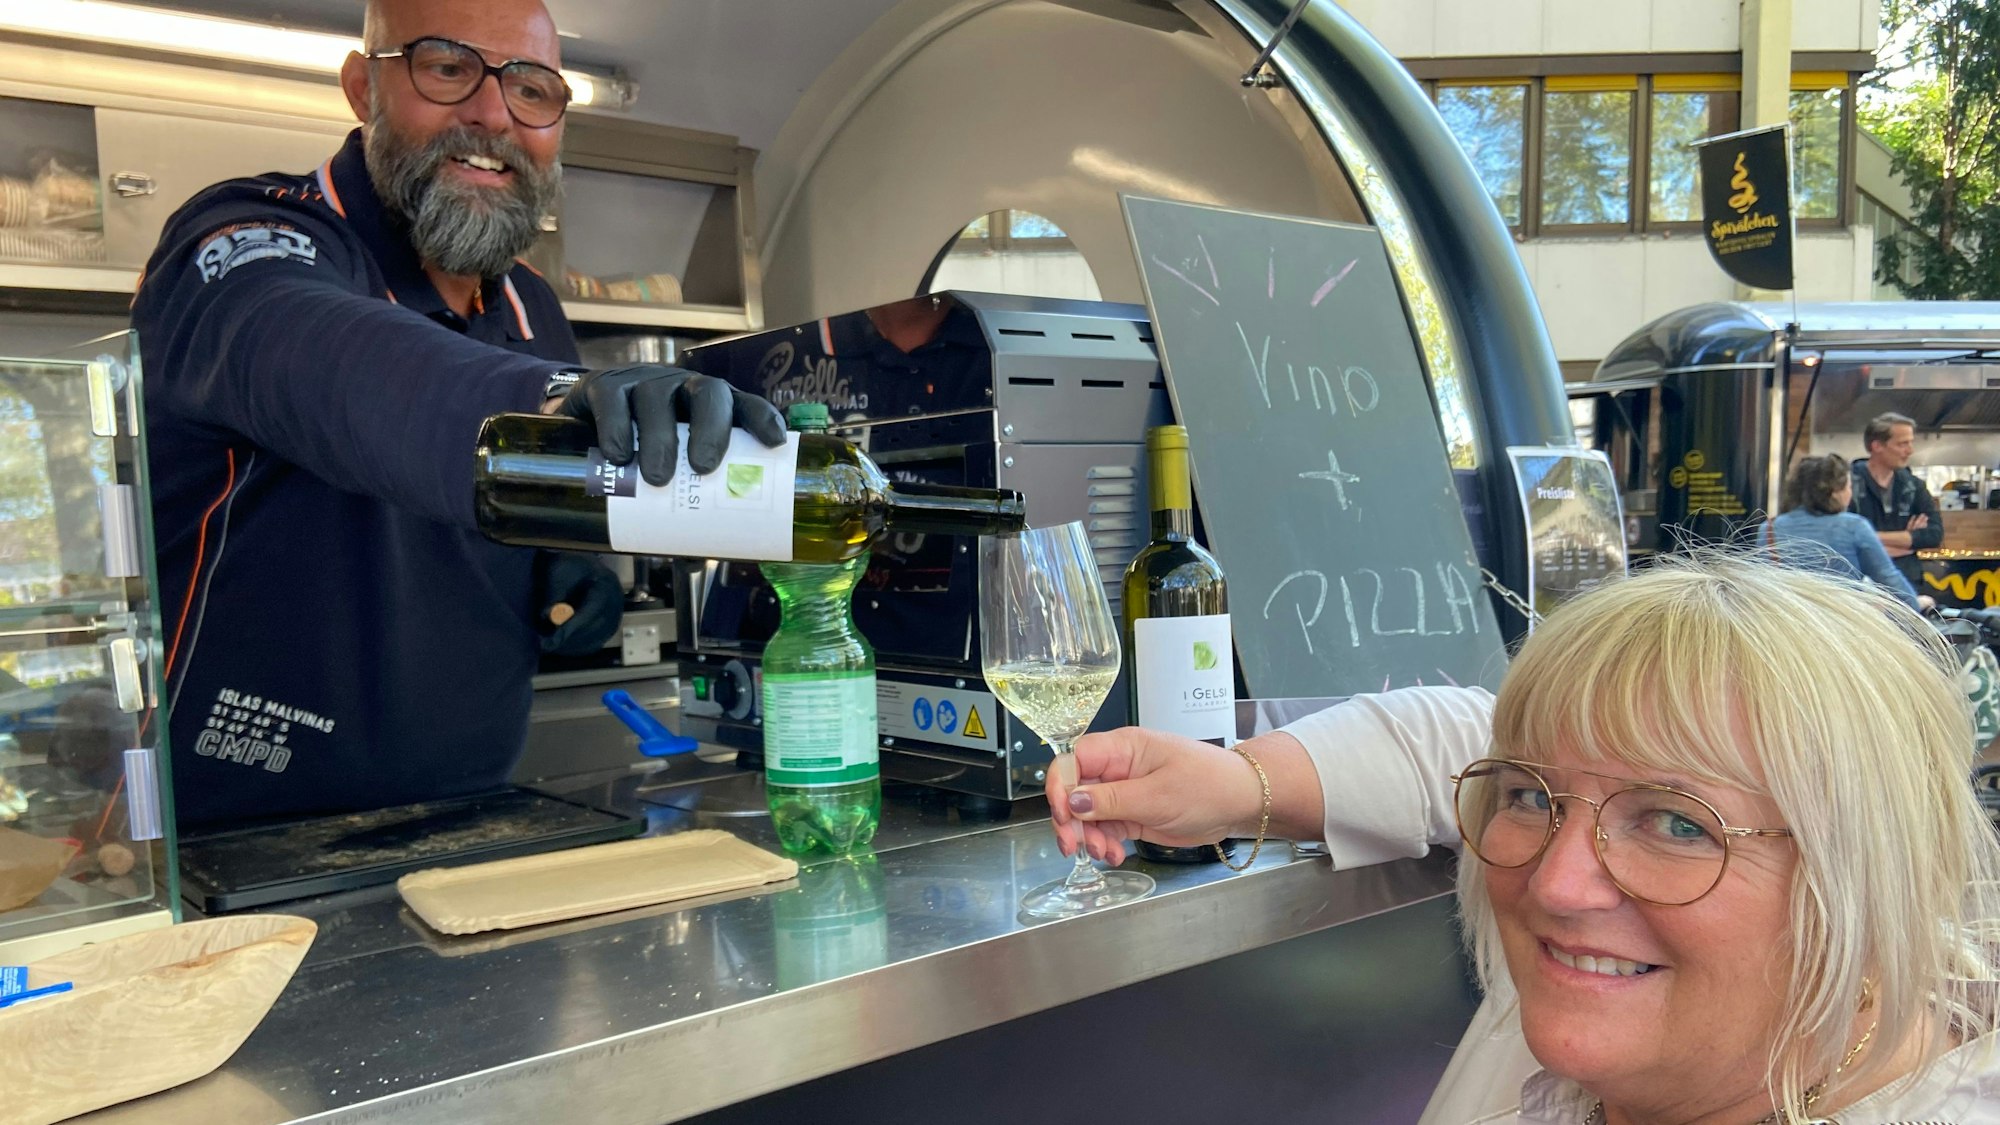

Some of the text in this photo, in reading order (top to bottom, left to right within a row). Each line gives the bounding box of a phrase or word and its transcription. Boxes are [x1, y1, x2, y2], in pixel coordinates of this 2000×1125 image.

[1235, 321, 1380, 419] Vino
[603, 459, 616, 494] ATTI
[689, 473, 702, 510] ELSI
[1536, 487, 1576, 500] Preisliste
[1263, 560, 1480, 655] PIZZA
[218, 688, 336, 733] ISLAS MALVINAS
[195, 728, 292, 774] CMPD
